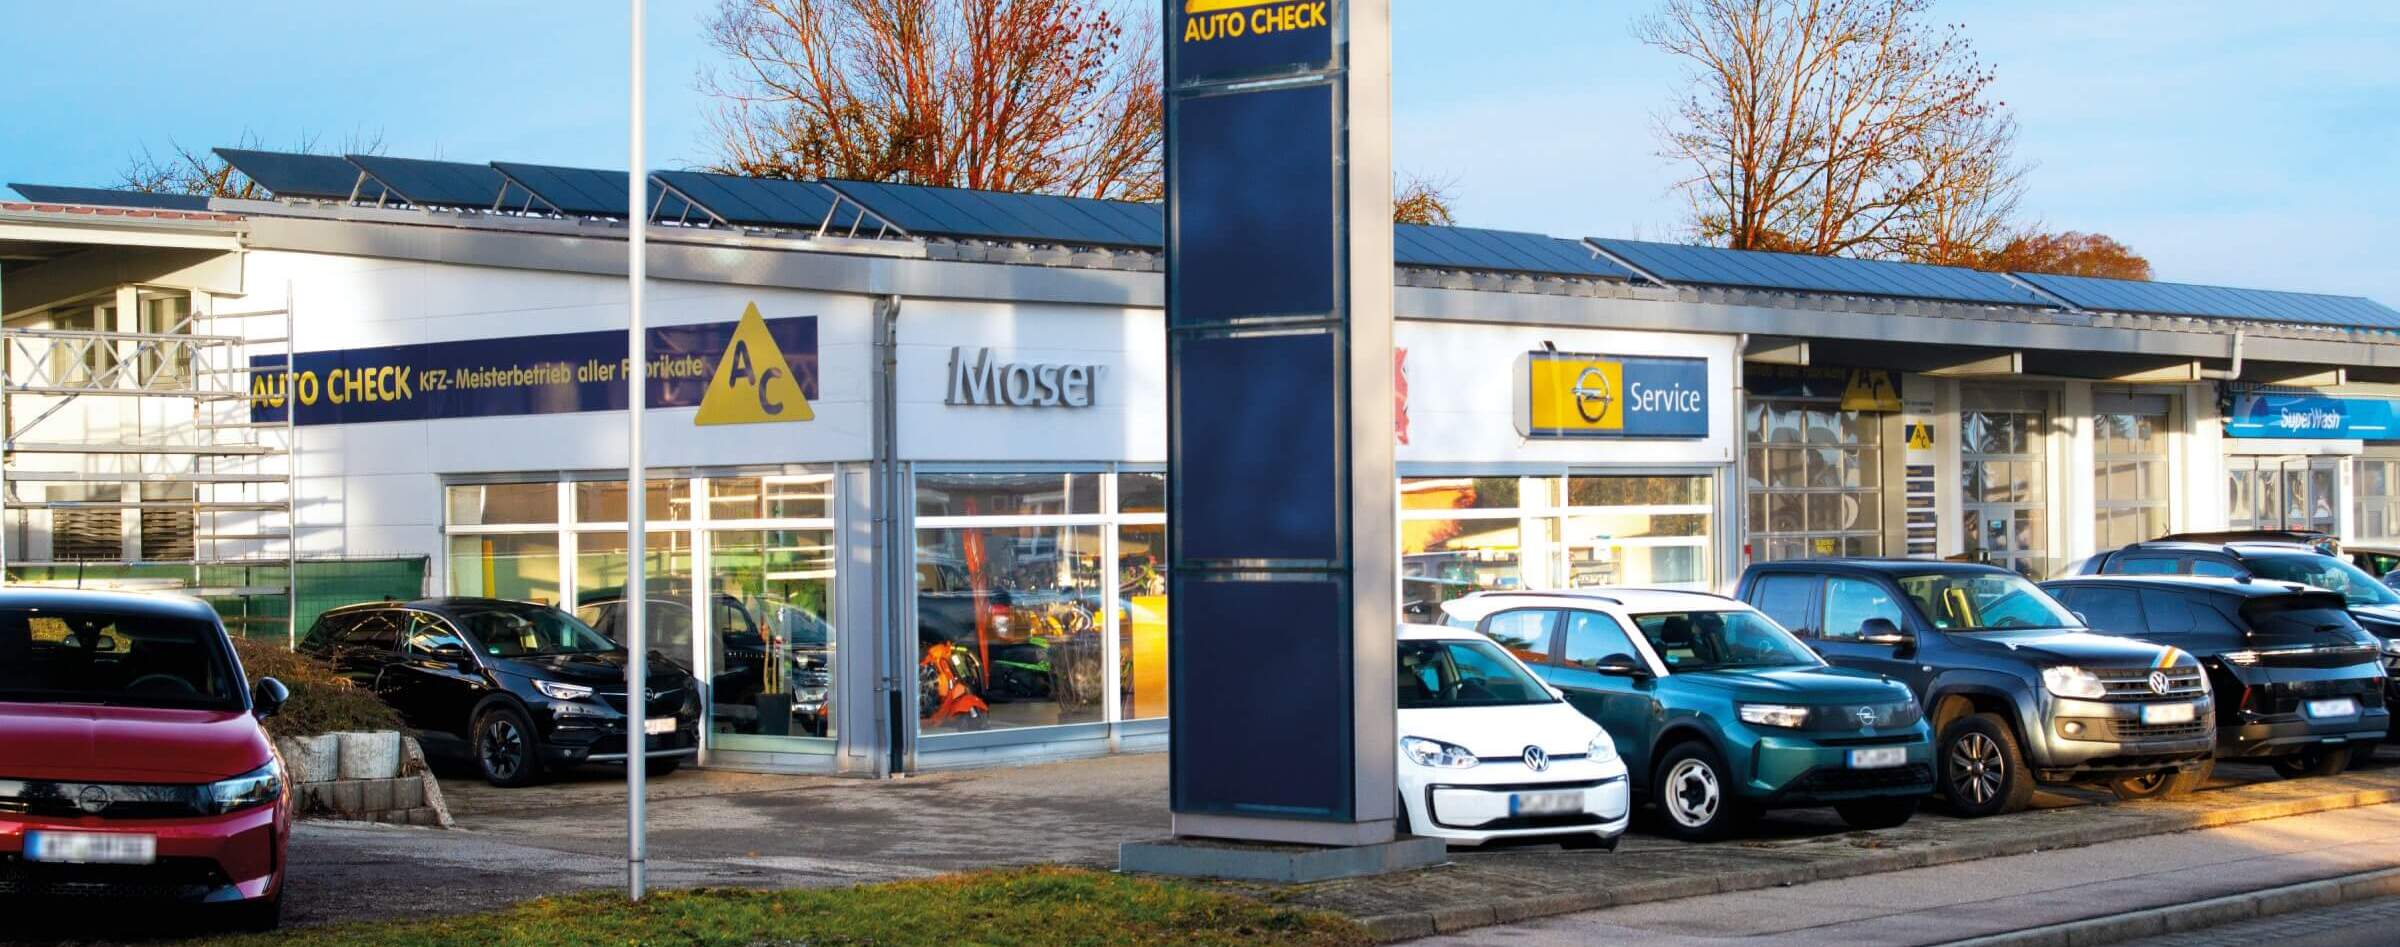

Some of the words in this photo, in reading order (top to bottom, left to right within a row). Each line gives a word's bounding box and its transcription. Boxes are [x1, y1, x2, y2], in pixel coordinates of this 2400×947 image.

[1184, 12, 1246, 43] AUTO
[1251, 1, 1327, 34] CHECK
[251, 370, 319, 409] AUTO
[327, 365, 413, 404] CHECK
[577, 357, 616, 383] aller
[945, 346, 1112, 407] Moser
[1631, 382, 1701, 412] Service
[2280, 407, 2340, 432] SuperWash
